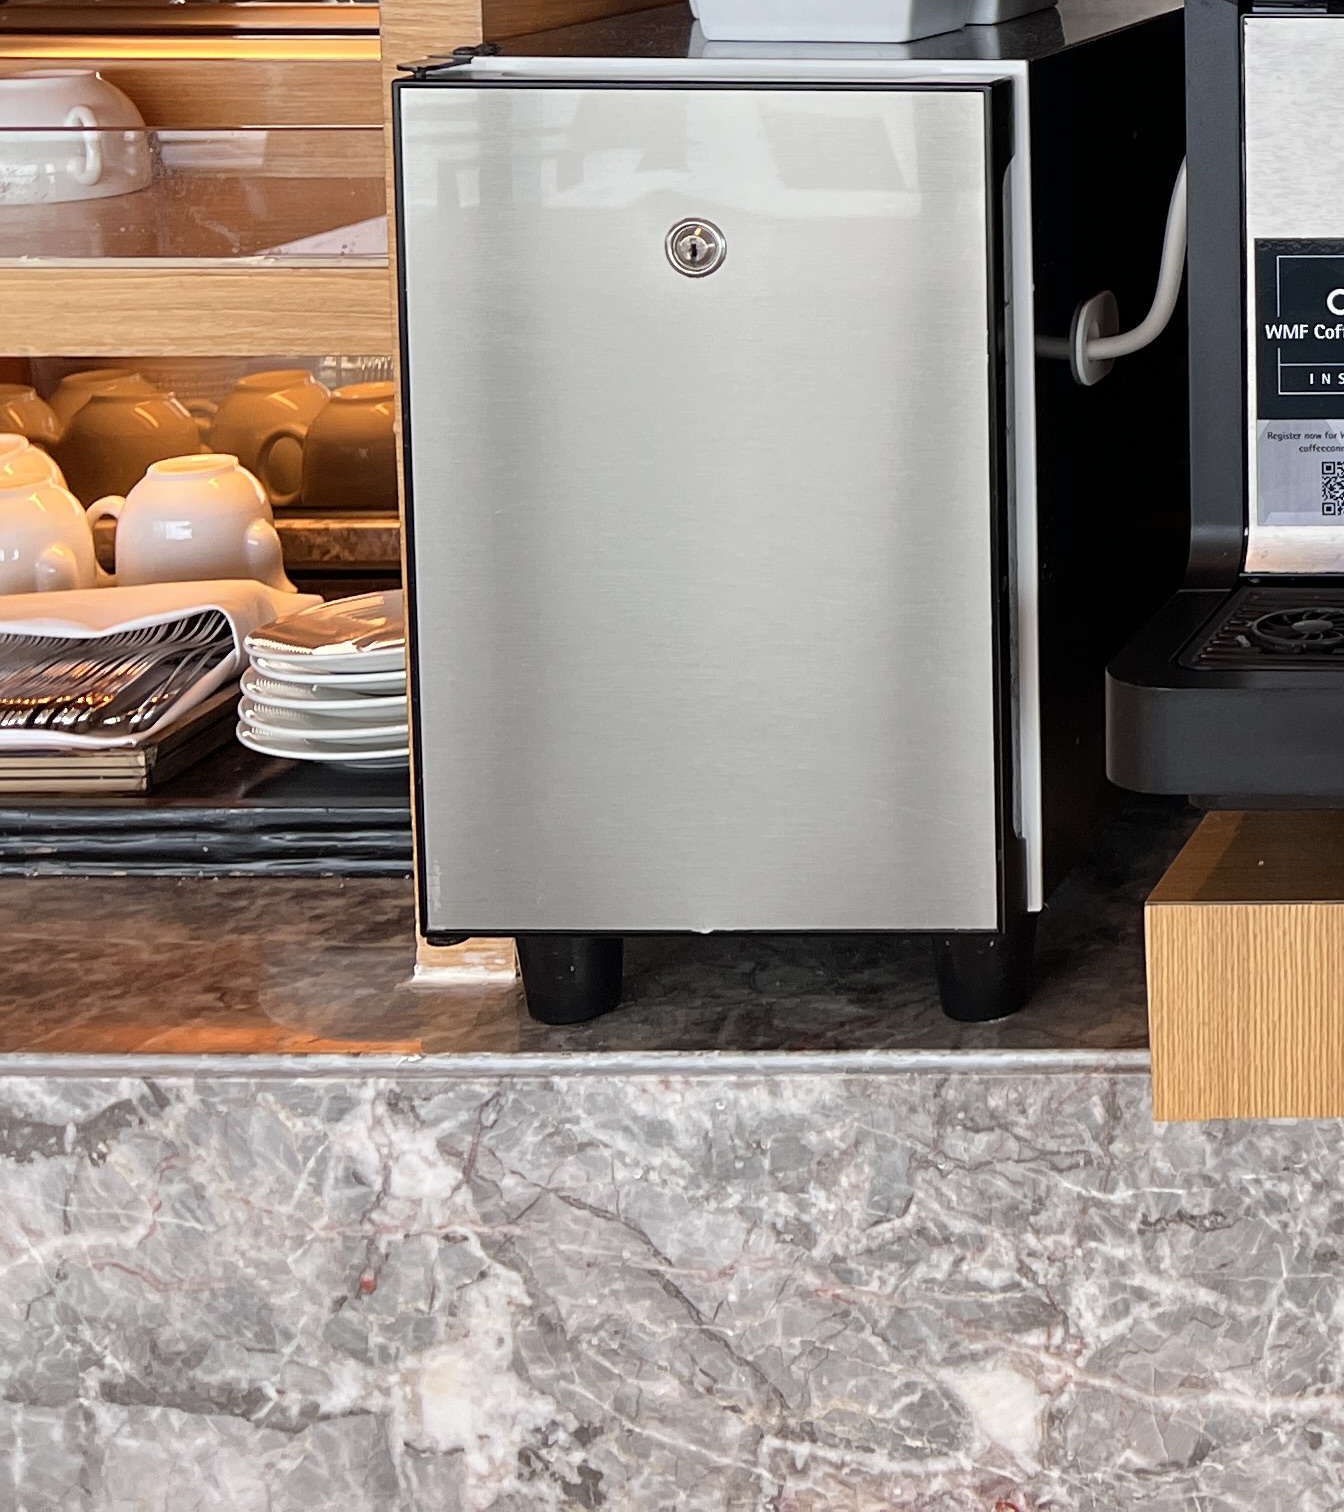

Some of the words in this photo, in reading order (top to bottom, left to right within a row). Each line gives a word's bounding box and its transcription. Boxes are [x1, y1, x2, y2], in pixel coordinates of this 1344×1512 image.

[1265, 324, 1309, 339] WMF
[1267, 431, 1302, 441] Register
[1325, 431, 1338, 439] for
